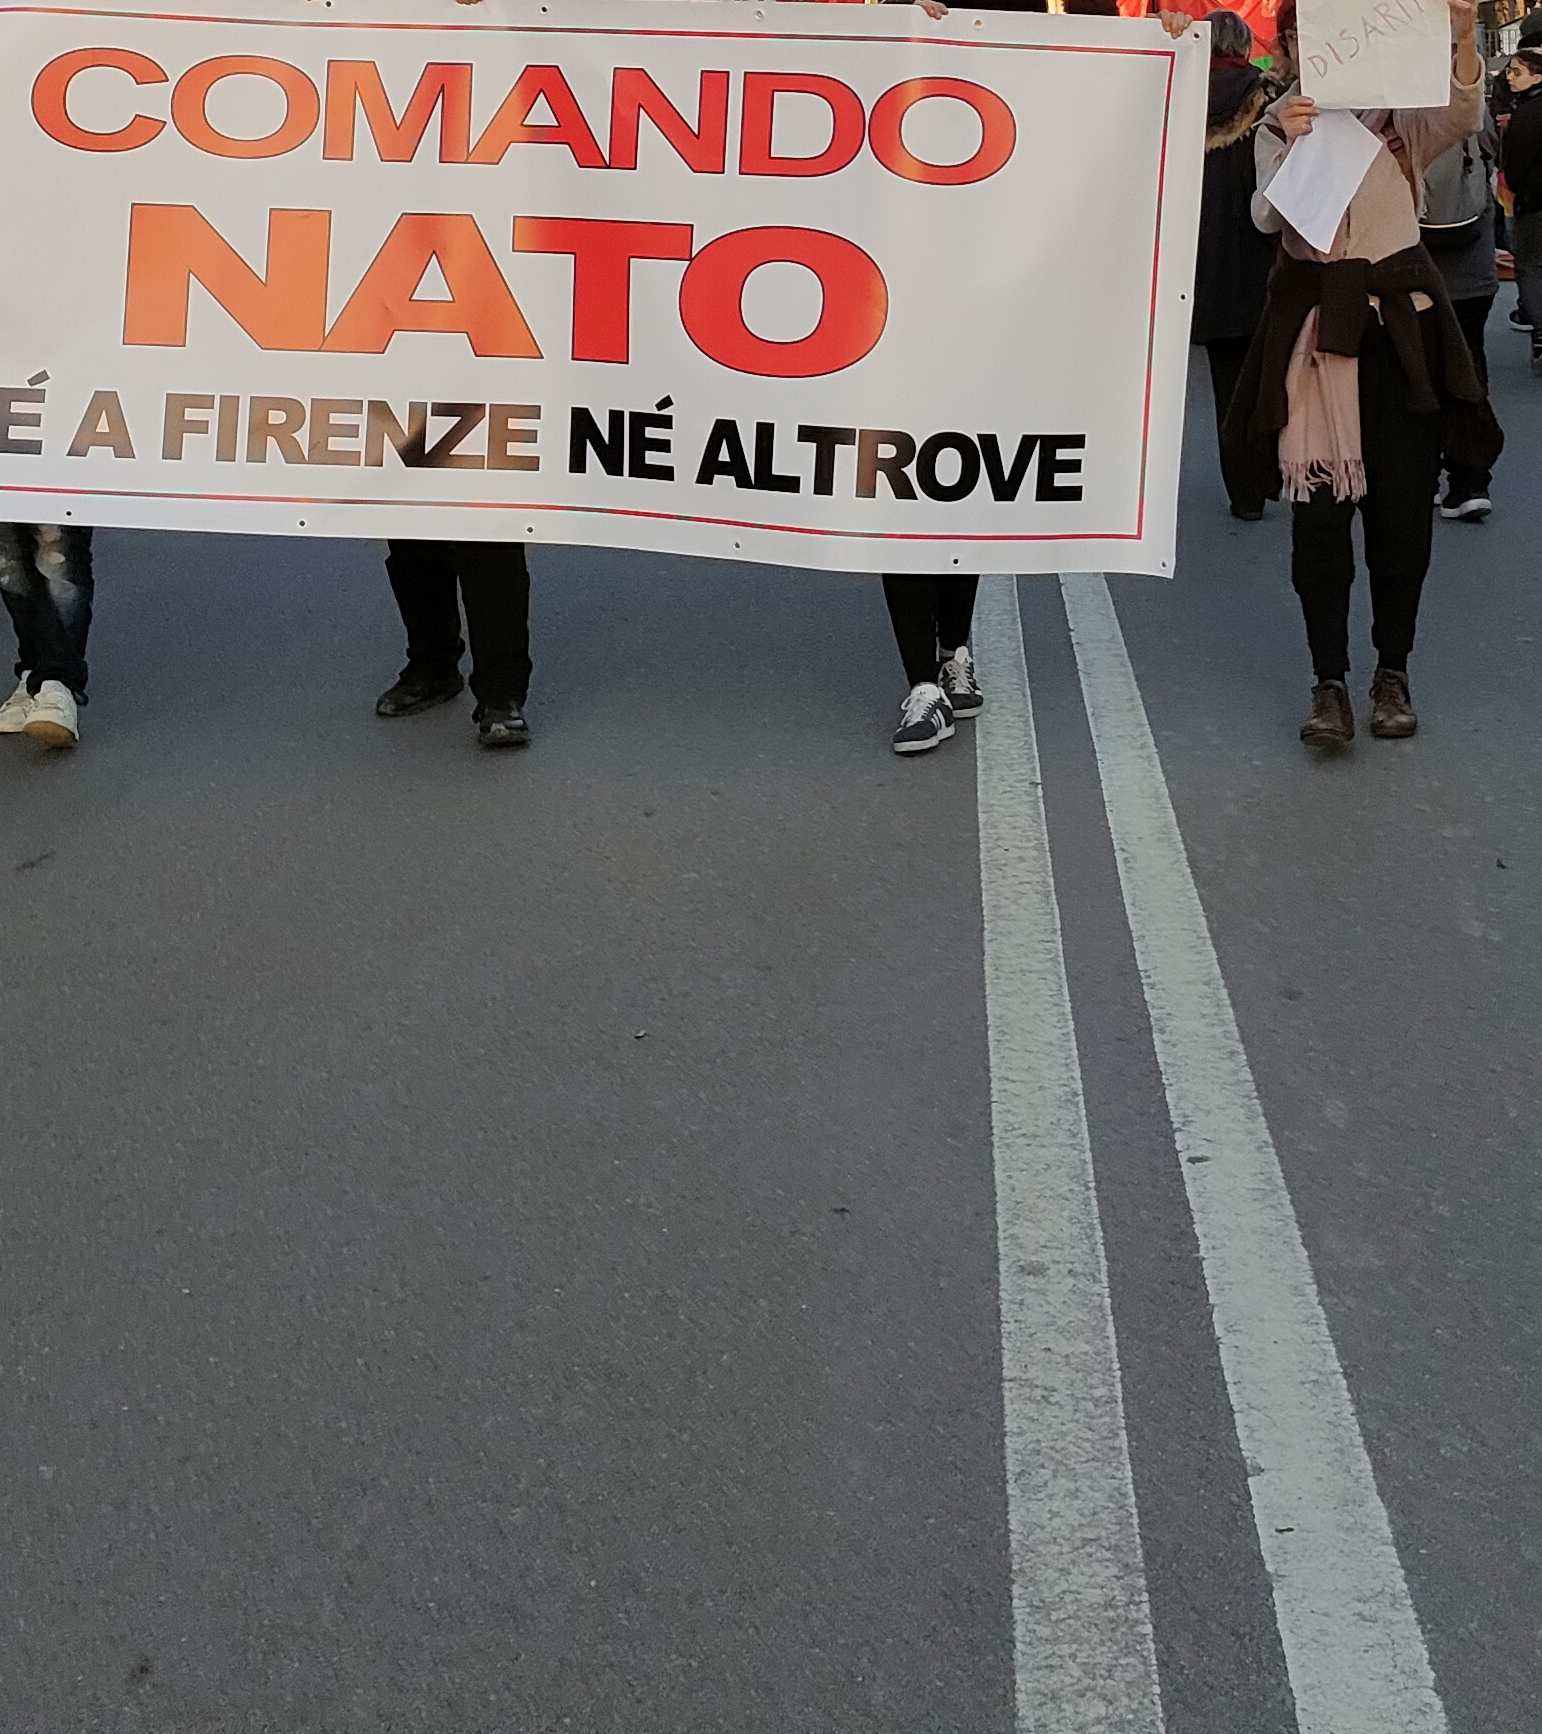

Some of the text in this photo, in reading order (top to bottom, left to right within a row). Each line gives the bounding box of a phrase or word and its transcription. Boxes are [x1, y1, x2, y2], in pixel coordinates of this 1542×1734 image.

[31, 48, 1016, 186] COMANDO
[123, 203, 888, 378] NATO
[66, 390, 136, 460] A
[162, 393, 541, 472] FIRENZE
[569, 394, 675, 482] NÉ
[695, 419, 1086, 503] ALTROVE
